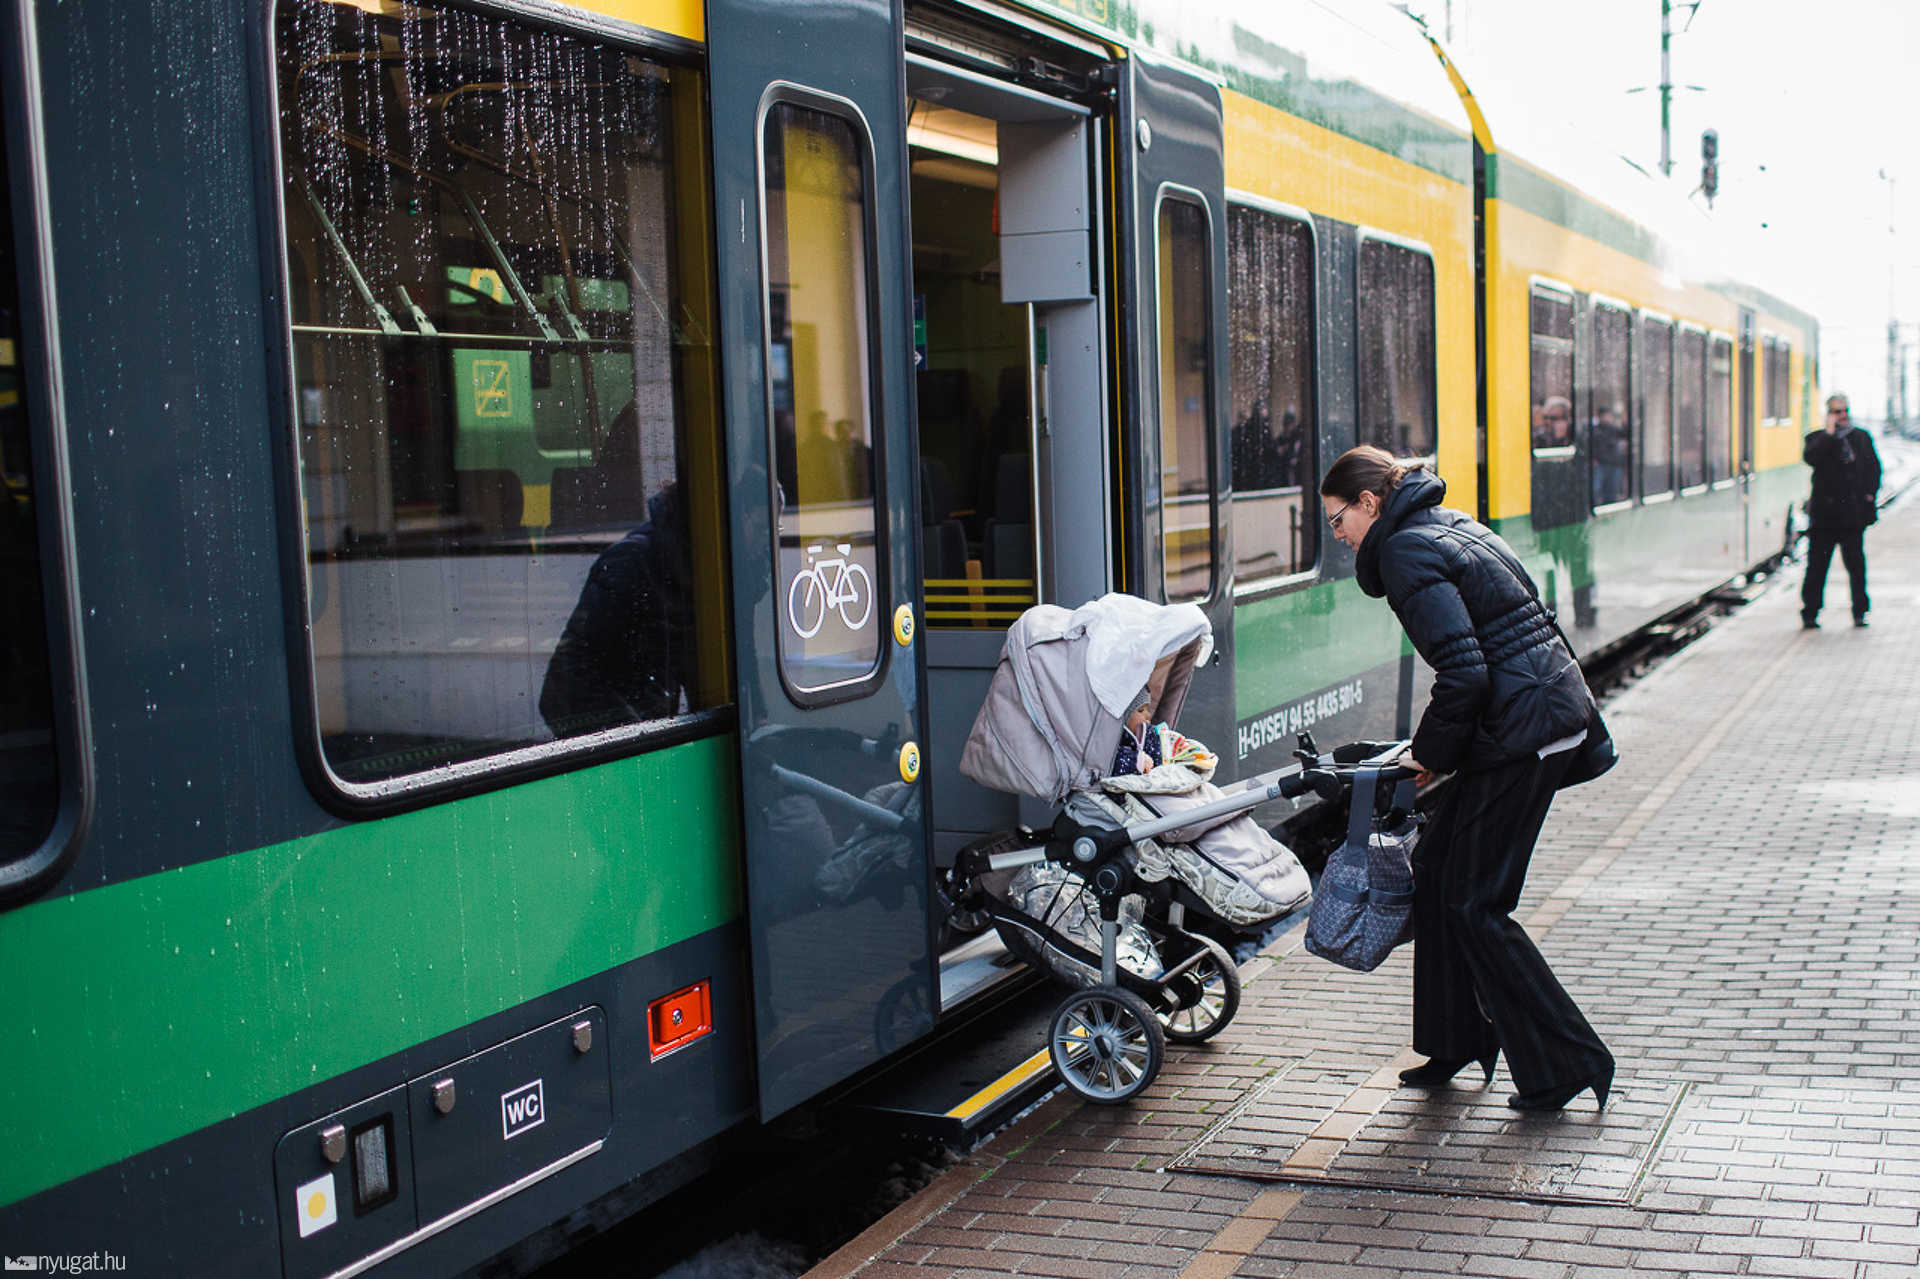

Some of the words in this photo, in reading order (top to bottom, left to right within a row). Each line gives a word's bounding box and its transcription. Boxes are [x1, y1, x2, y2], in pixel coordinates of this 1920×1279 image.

[1238, 709, 1289, 760] H-GYSEV
[1289, 703, 1302, 733] 94
[1303, 699, 1316, 727] 55
[507, 1094, 539, 1125] WC
